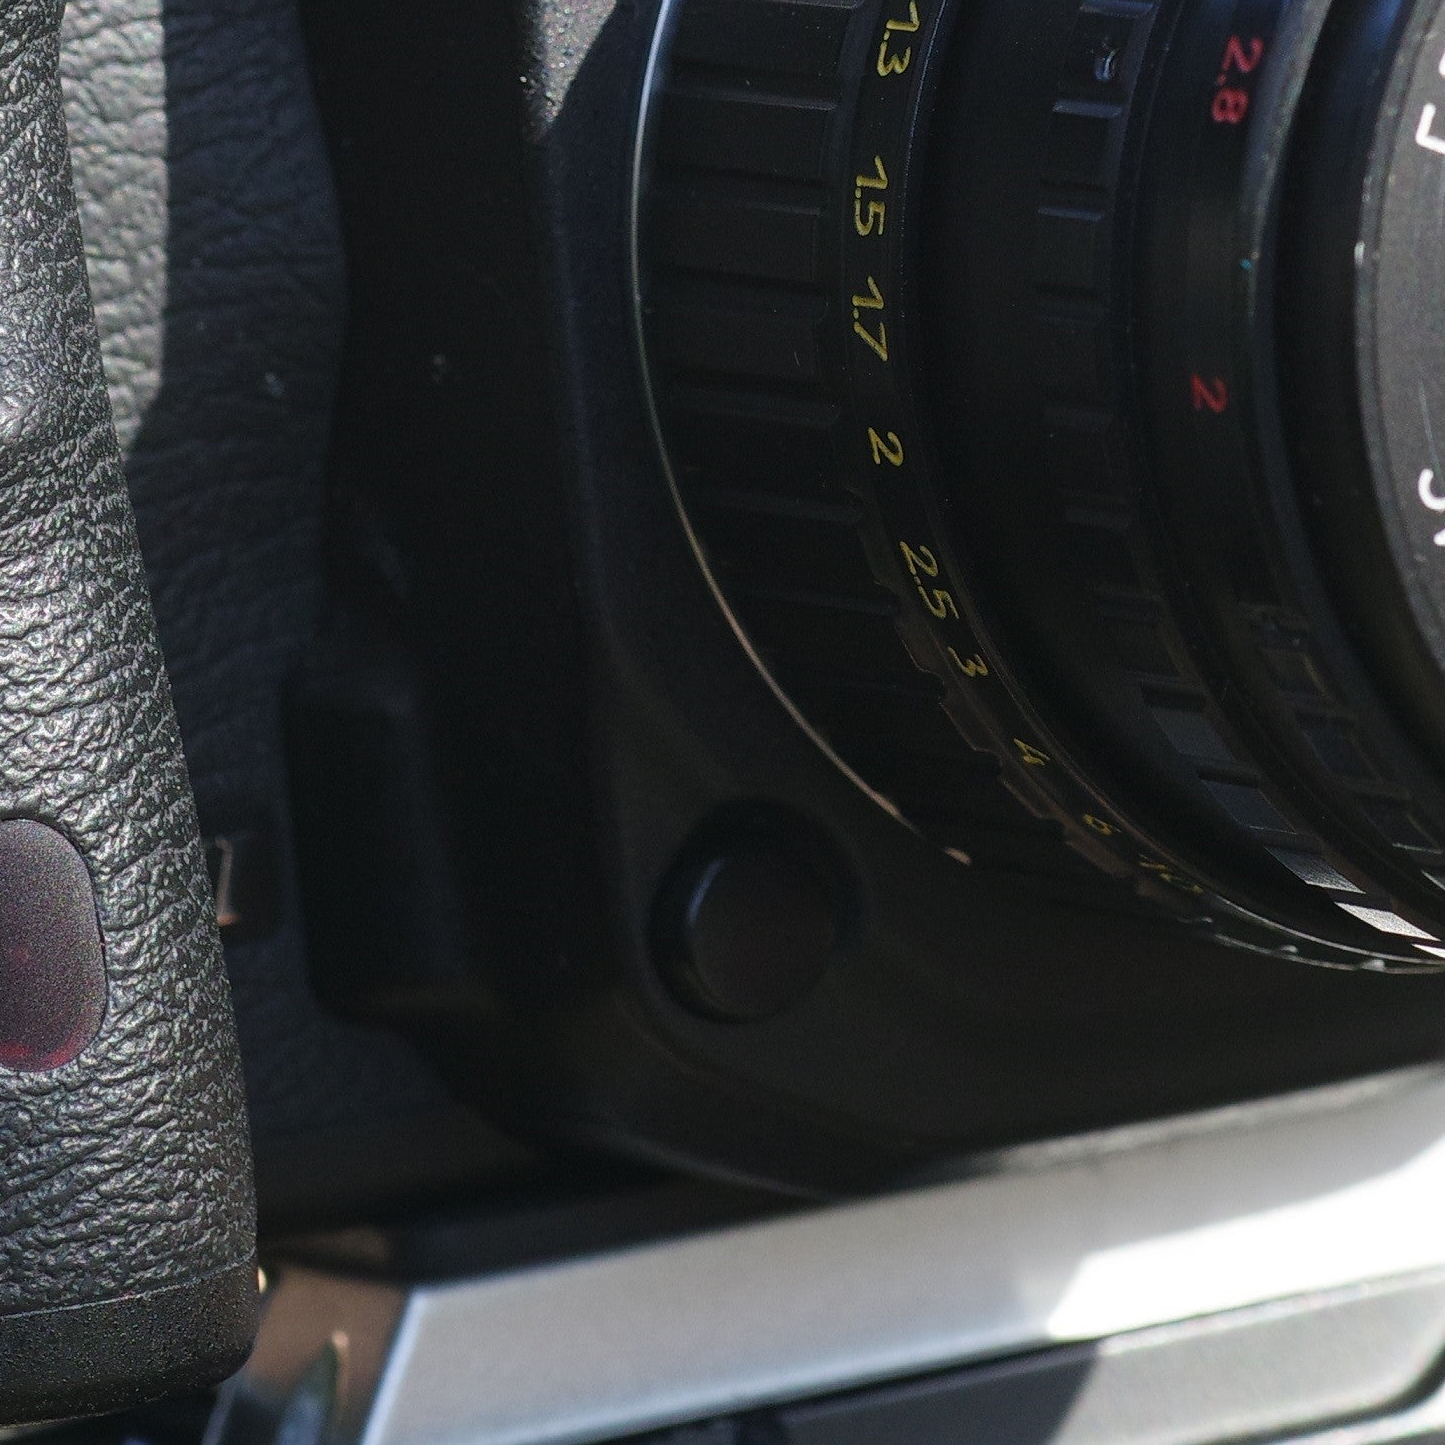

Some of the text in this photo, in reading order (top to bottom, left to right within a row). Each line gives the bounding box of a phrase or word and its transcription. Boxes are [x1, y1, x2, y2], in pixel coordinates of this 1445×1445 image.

[877, 0, 921, 76] 1.3
[1211, 35, 1263, 123] 2.8
[855, 156, 889, 236] 1.5
[852, 276, 888, 361] 1.7
[1190, 373, 1228, 413] 2
[867, 427, 904, 467] 2
[900, 541, 959, 621] 2.5
[948, 646, 989, 677] 3
